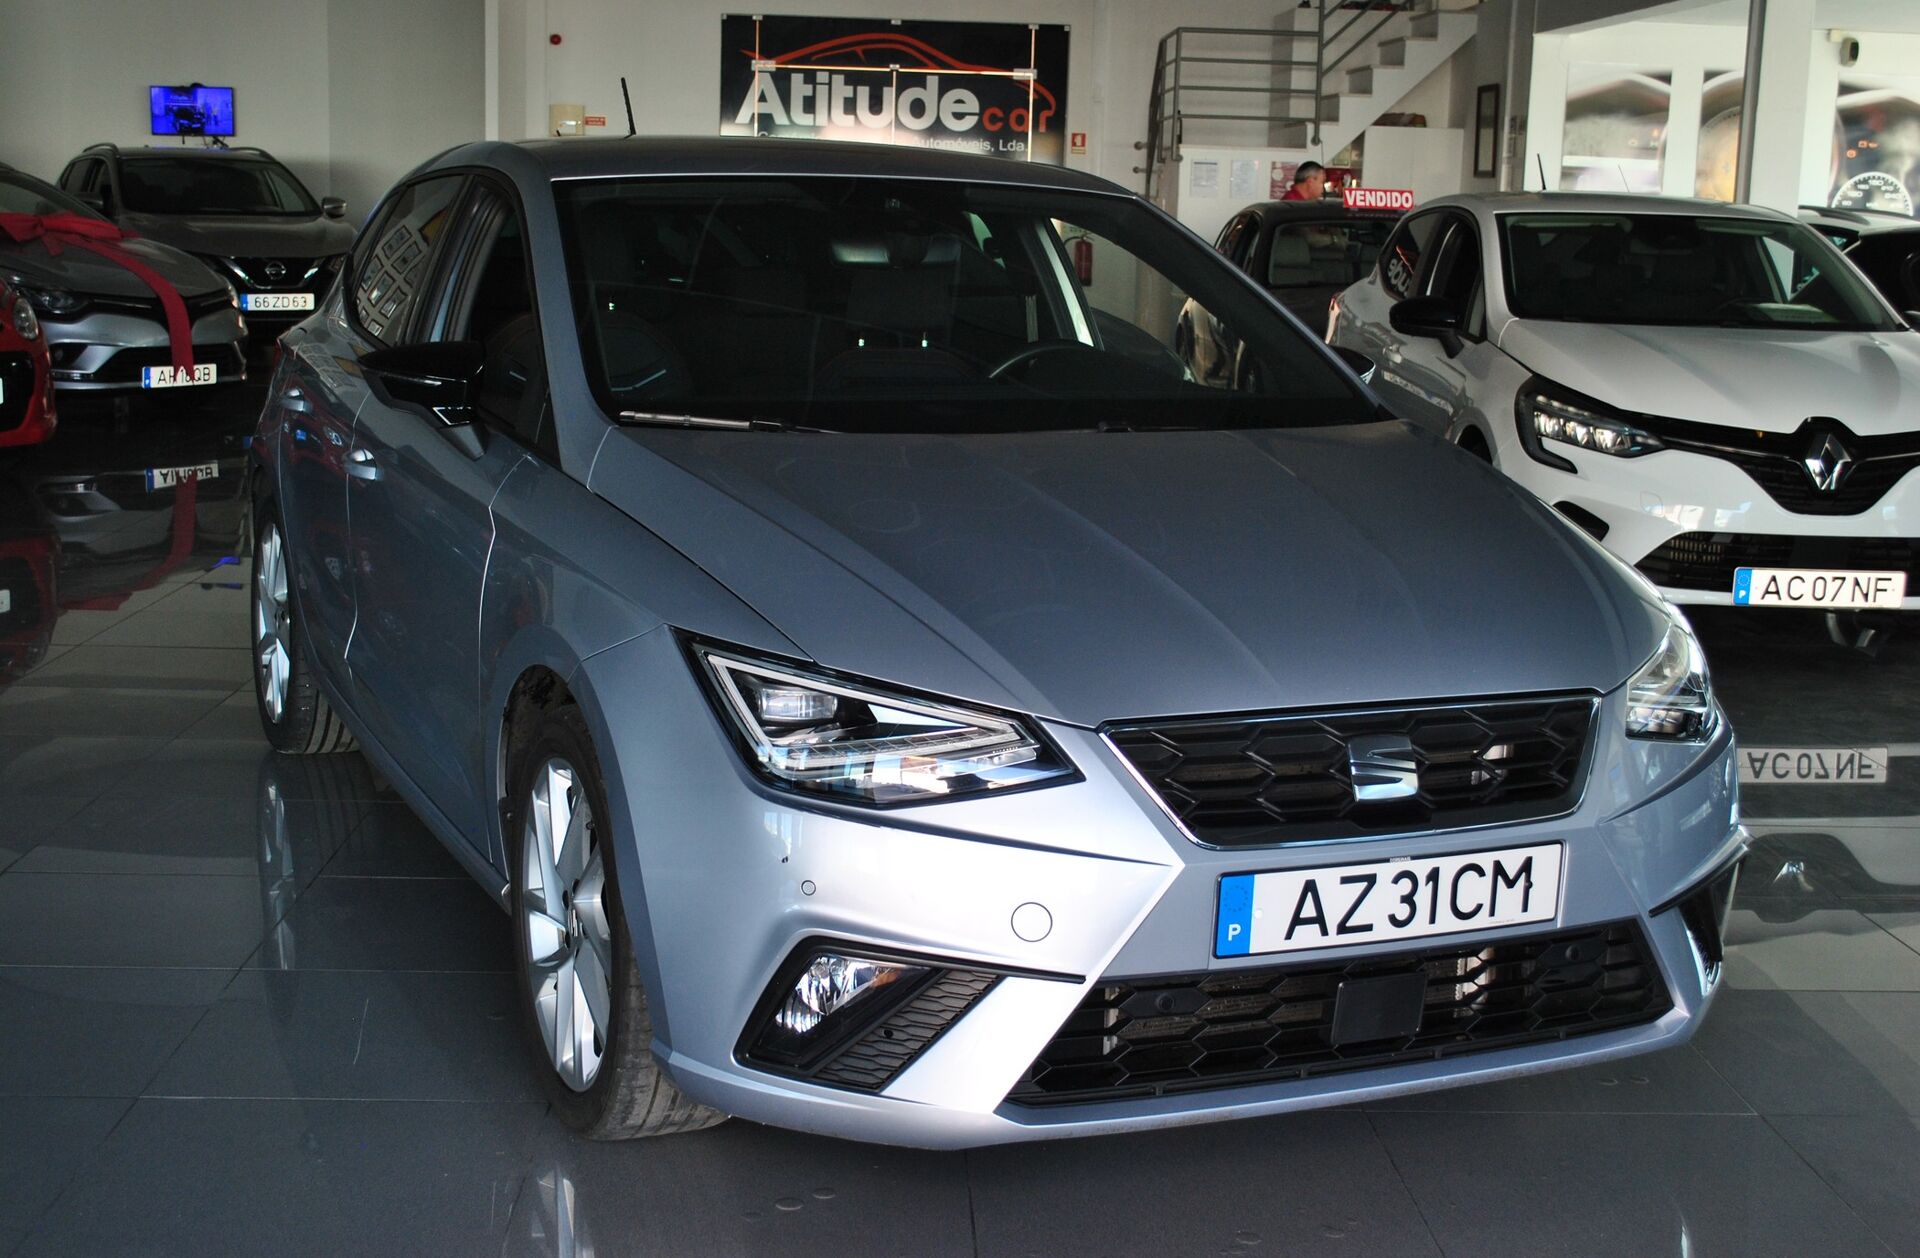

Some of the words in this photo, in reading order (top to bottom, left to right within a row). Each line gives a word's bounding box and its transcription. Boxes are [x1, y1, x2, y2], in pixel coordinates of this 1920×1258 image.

[1345, 190, 1413, 208] VENDIDO
[1760, 574, 1893, 603] AC07NF
[1227, 923, 1241, 942] P
[1283, 855, 1534, 942] AZ31CM
